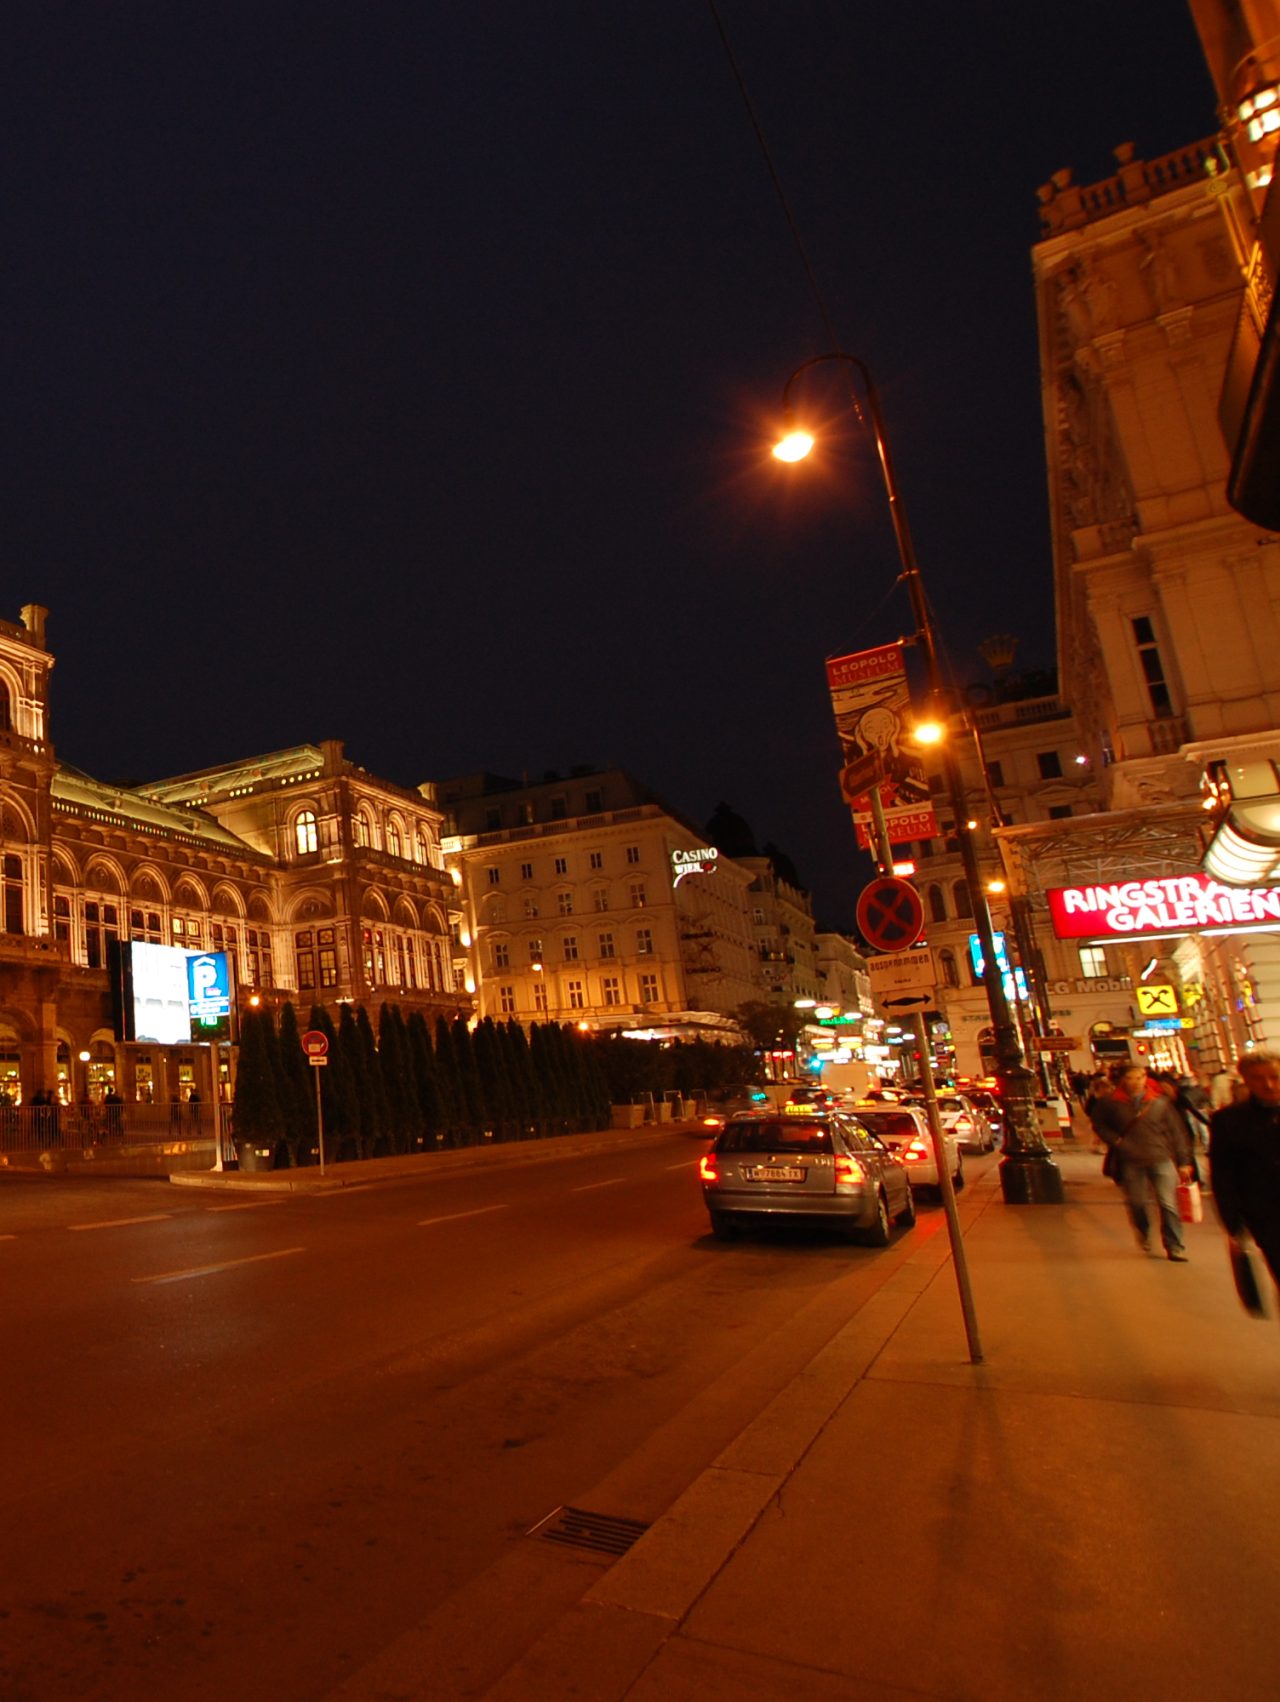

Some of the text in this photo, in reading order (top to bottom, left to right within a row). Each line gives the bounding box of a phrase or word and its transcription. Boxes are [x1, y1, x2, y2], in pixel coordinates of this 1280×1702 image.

[832, 652, 897, 675] LEOPOLD
[834, 661, 899, 682] MUSEUM
[673, 847, 718, 864] CASINO
[1106, 891, 1280, 931] GALERIEN
